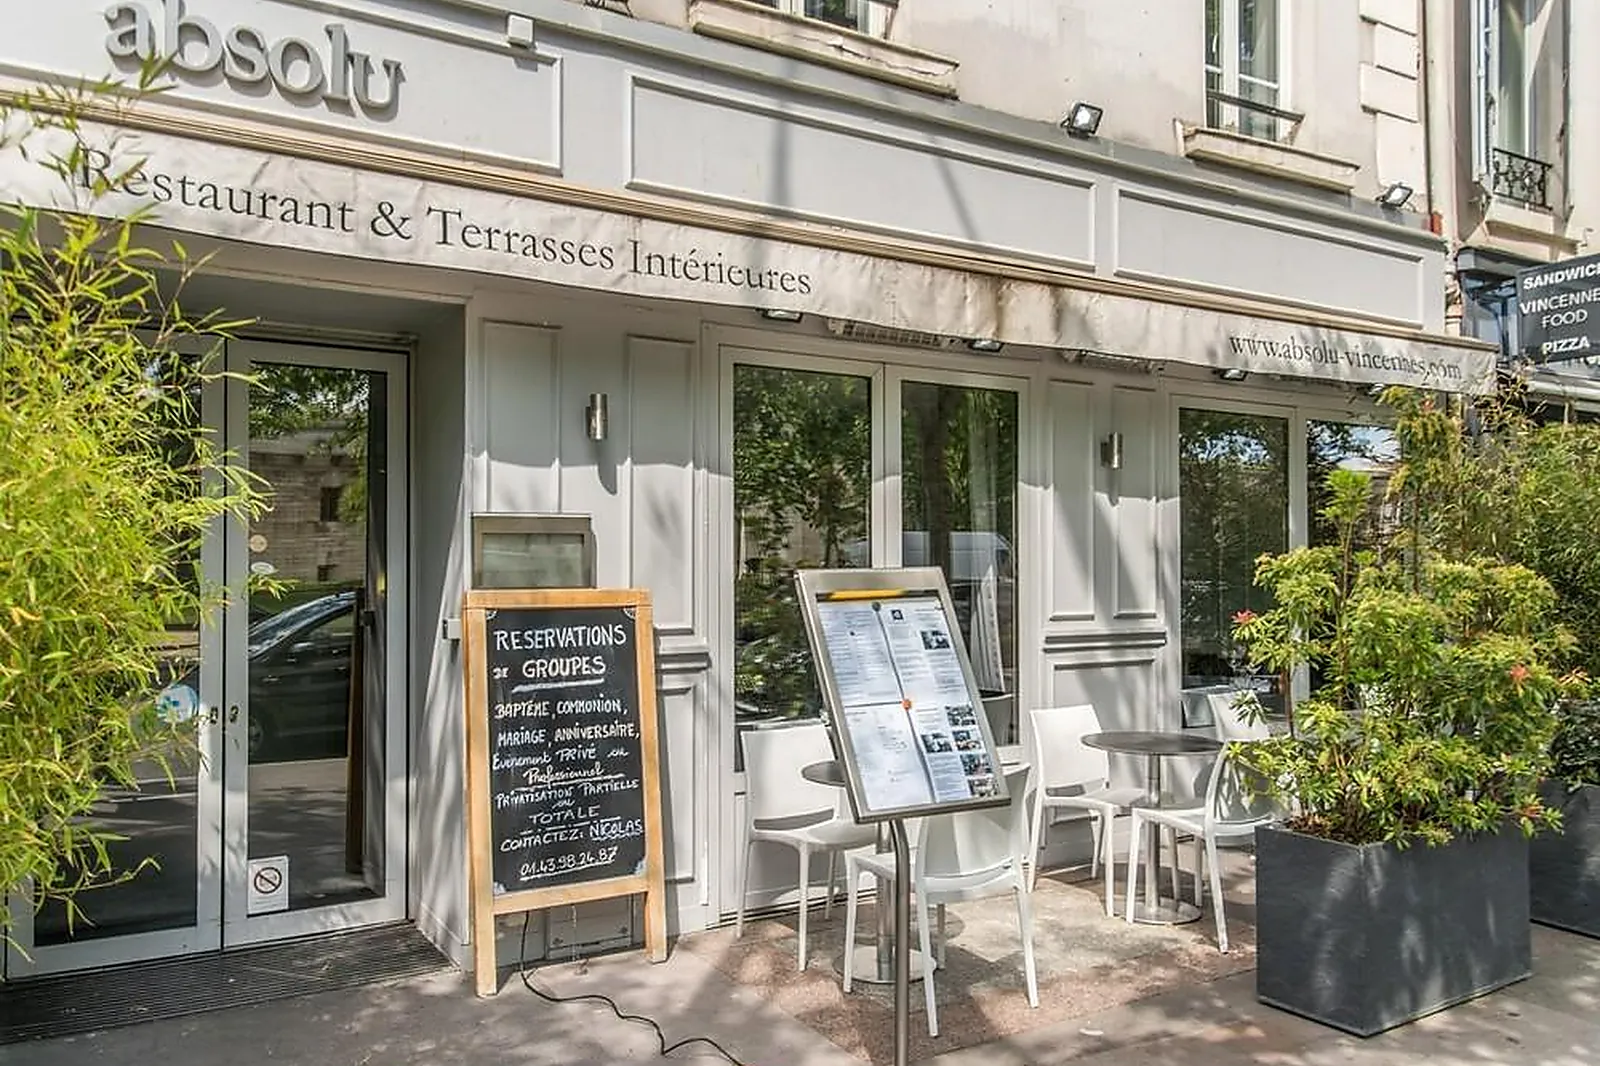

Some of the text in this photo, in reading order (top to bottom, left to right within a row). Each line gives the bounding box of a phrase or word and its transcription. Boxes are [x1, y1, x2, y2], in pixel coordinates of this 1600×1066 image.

[104, 0, 405, 112] absolu
[78, 148, 812, 295] Restaurant & Terrasses Intérieures
[1541, 308, 1588, 328] FOOD
[1542, 335, 1591, 355] PIZZA
[1229, 335, 1463, 380] www.absolu-vincennes.com
[493, 623, 627, 651] RESERVATIONS
[522, 655, 606, 678] GROUPES
[528, 804, 601, 825] TOTALE
[589, 819, 643, 839] NICOLAS
